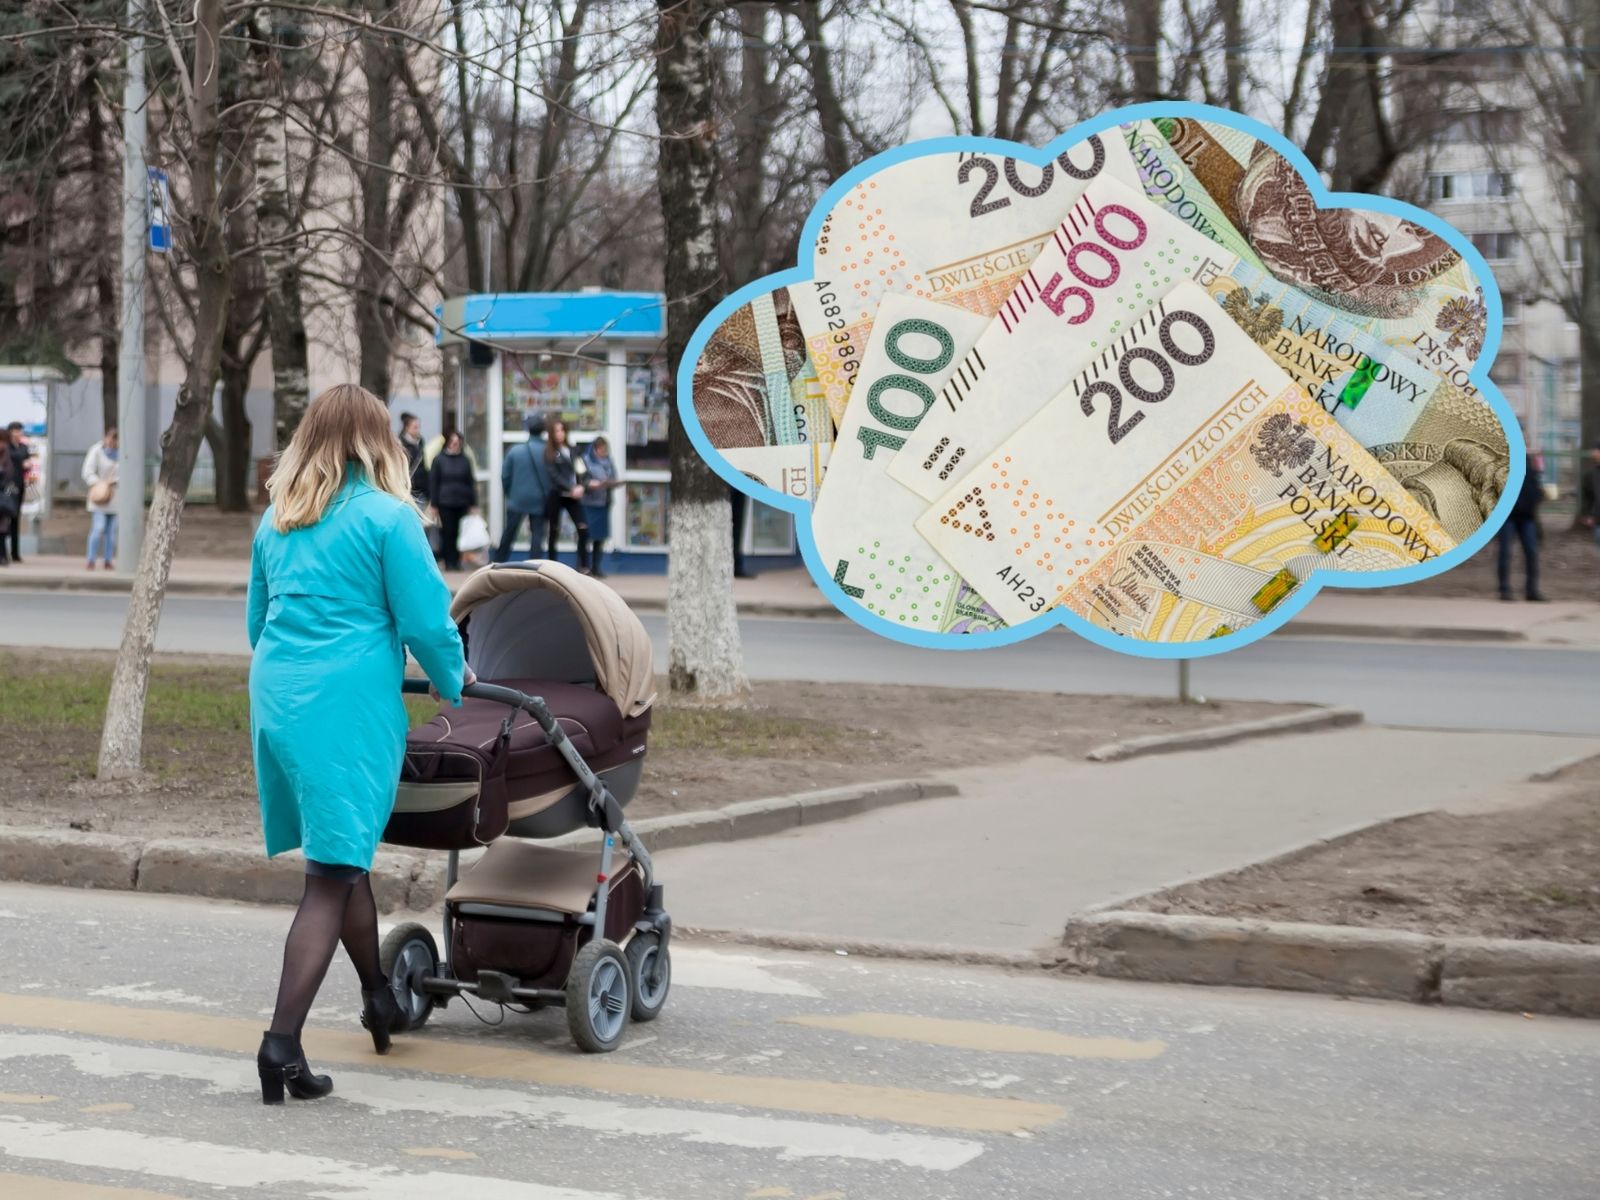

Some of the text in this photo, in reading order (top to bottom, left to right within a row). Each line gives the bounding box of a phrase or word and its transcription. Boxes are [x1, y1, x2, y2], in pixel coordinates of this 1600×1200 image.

[957, 133, 1106, 219] 200
[928, 249, 1031, 293] DWIEŚCIE
[1039, 204, 1148, 325] 500
[856, 318, 955, 461] 100
[1080, 310, 1216, 445] 200
[1275, 336, 1341, 386] BANK
[1281, 366, 1343, 416] SKI
[1288, 315, 1427, 403] NARODOWY
[1412, 330, 1478, 397] POLSKI
[1103, 385, 1269, 538] DWIEŚCIE ZŁOTYCH
[1373, 444, 1428, 460] SKI
[1277, 484, 1353, 558] POLSKI
[1297, 465, 1360, 527] BANK
[1317, 446, 1439, 563] NARODOWY
[996, 565, 1053, 612] AH23
[1127, 556, 1150, 580] PREZES
[1134, 549, 1145, 560] 30
[1142, 558, 1166, 583] MARCA
[1164, 580, 1181, 597] 2015
[1141, 544, 1181, 587] WARSZAWA
